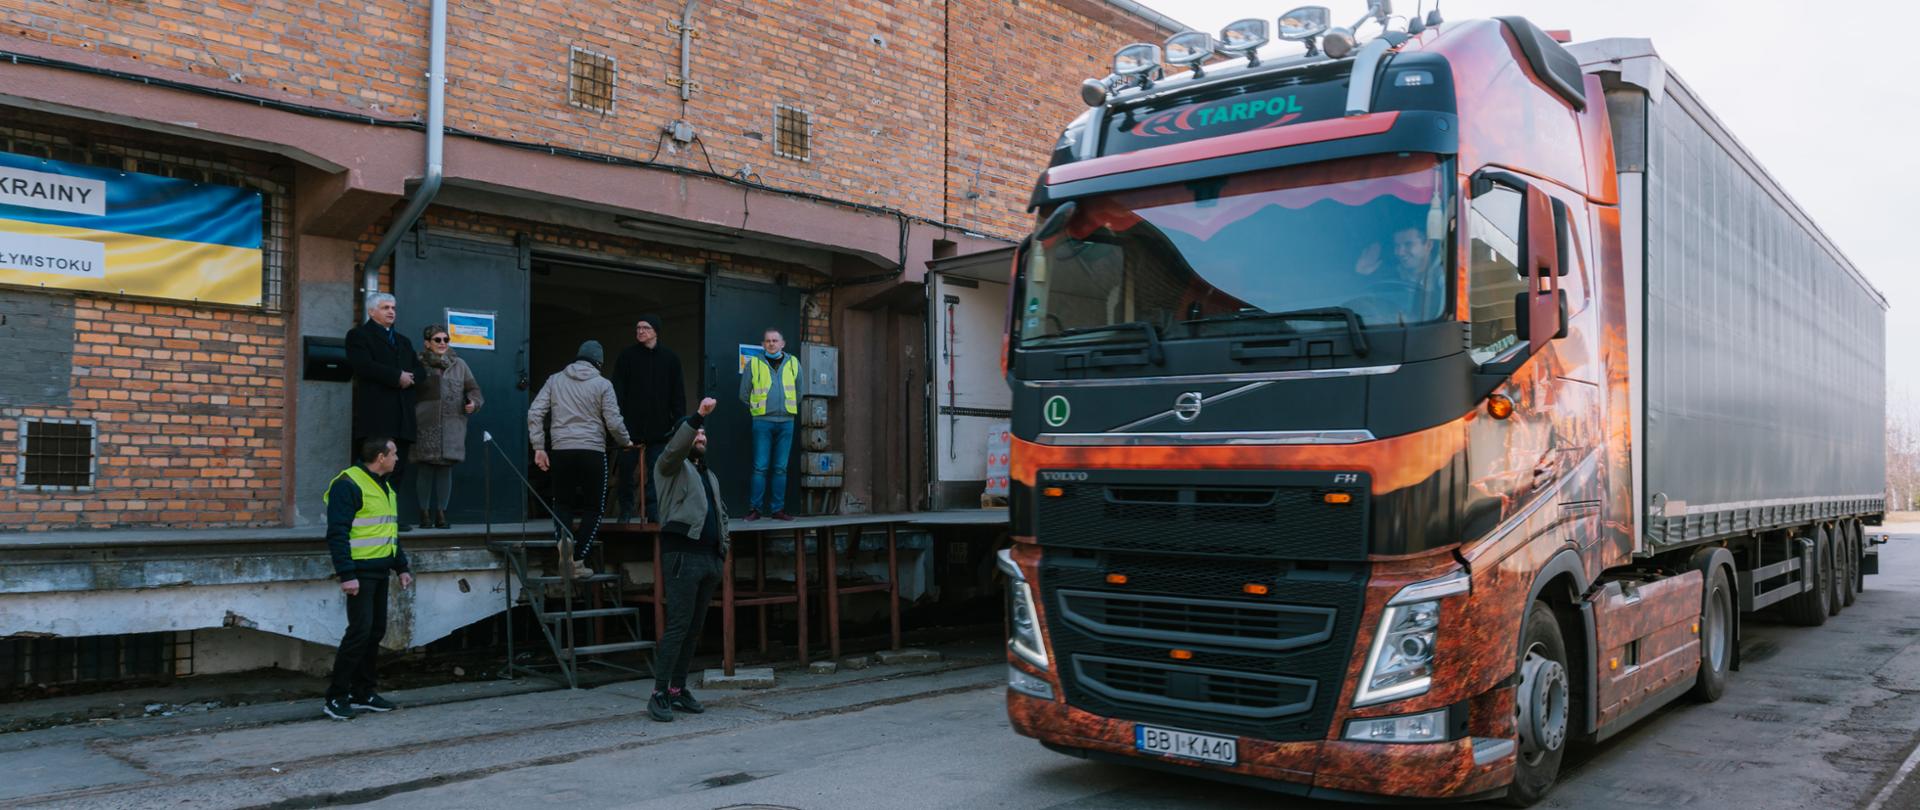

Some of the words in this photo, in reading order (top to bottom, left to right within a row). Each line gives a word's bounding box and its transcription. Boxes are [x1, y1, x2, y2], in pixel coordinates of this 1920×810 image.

[1197, 95, 1303, 126] TARPOL
[0, 177, 92, 204] KRAINY
[0, 252, 91, 272] ŁYMSTOKU
[1041, 471, 1088, 480] VOLVO
[1333, 473, 1358, 483] FH
